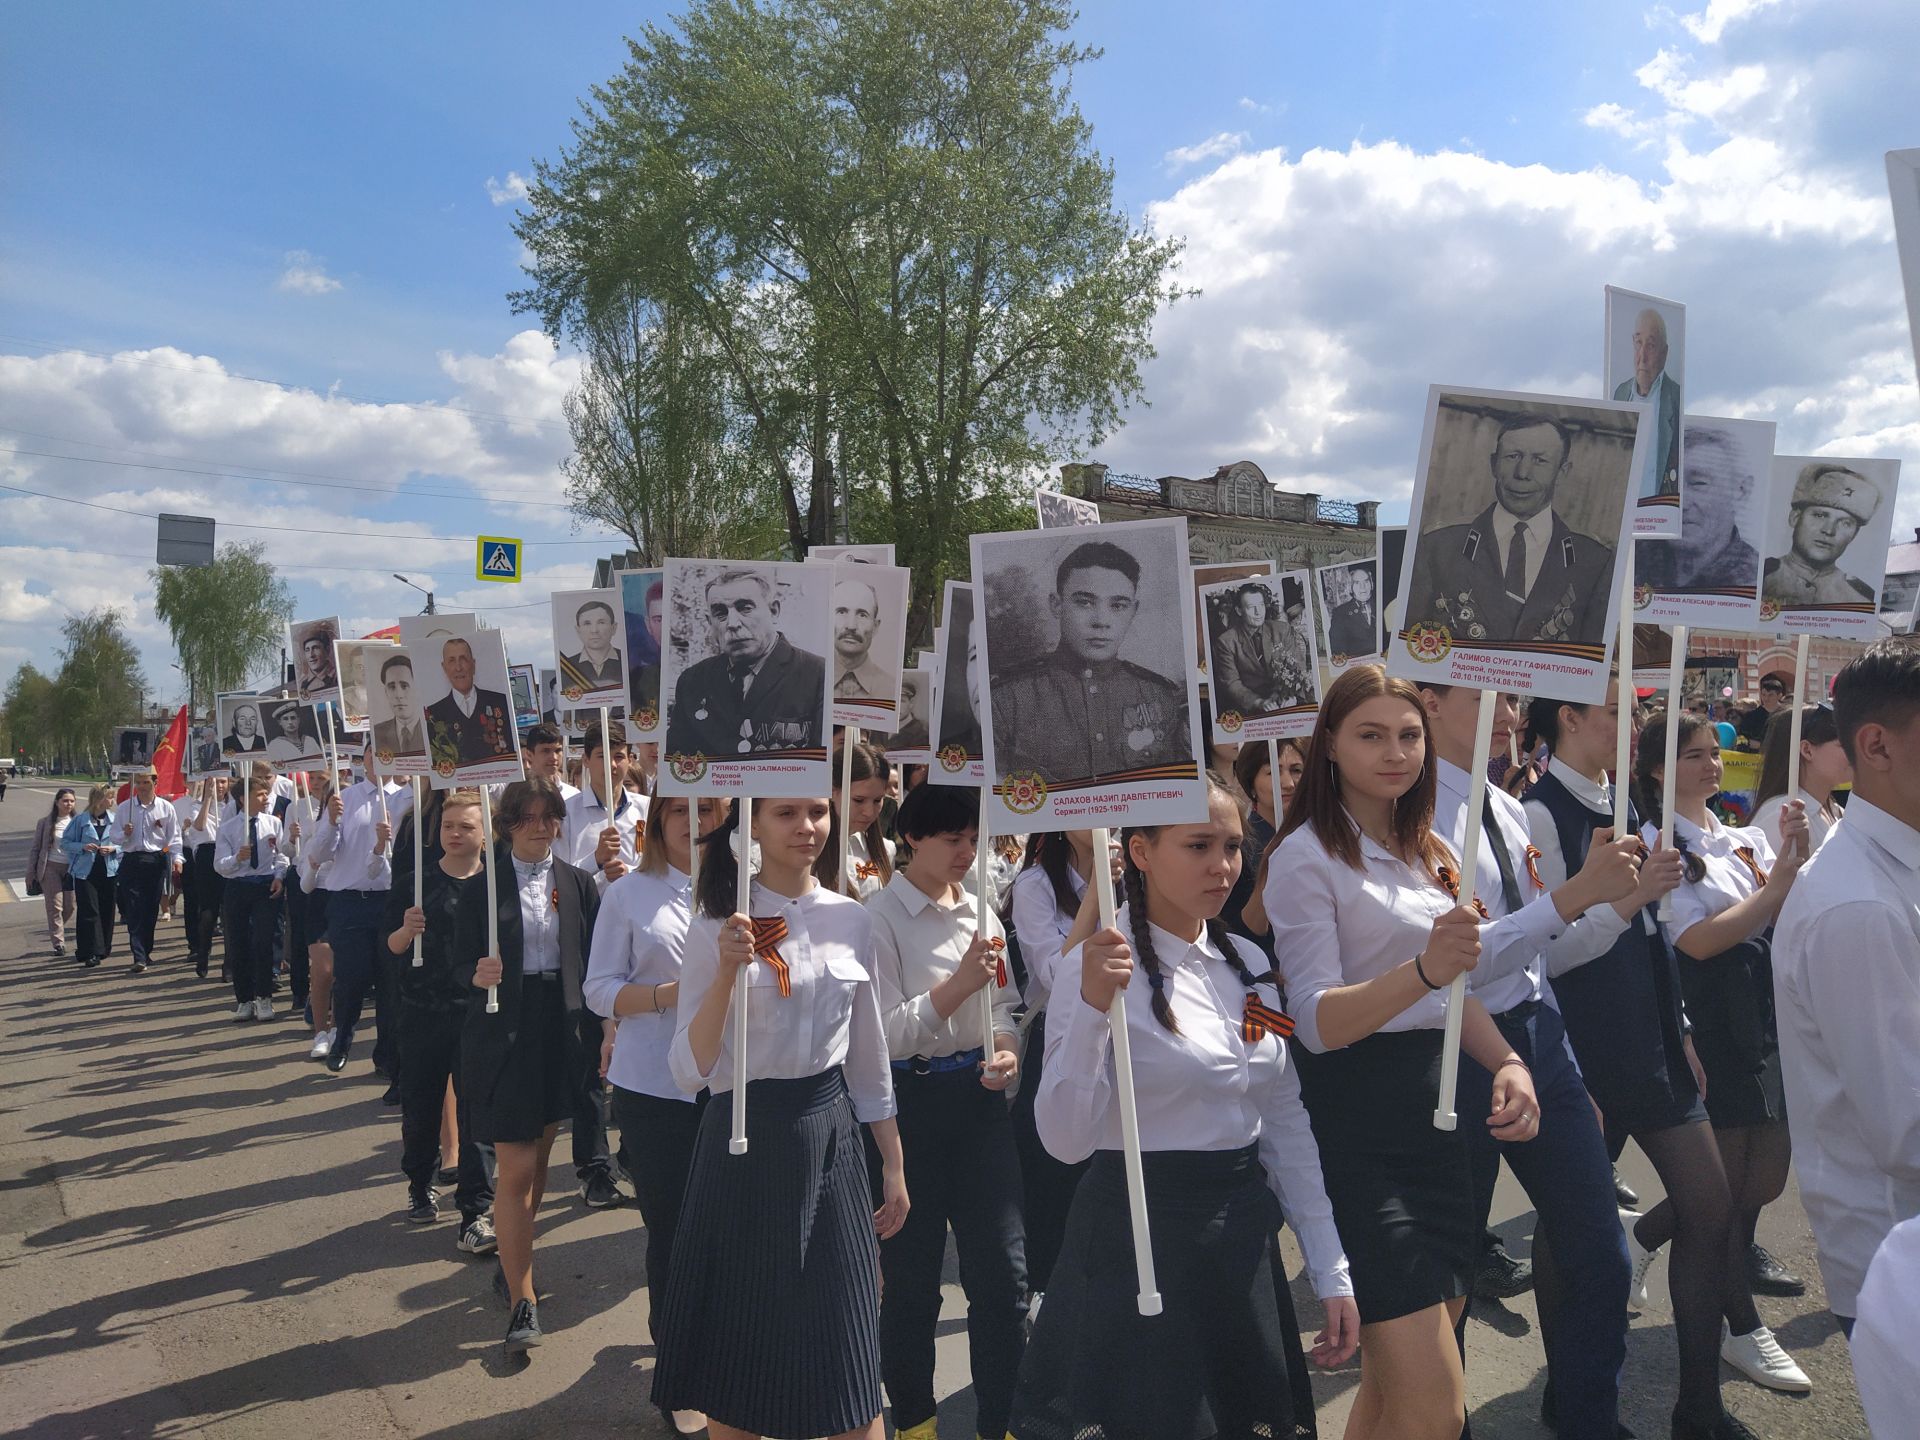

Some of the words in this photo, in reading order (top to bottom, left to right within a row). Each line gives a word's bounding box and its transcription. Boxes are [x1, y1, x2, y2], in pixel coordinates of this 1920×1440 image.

[1682, 598, 1716, 606] АЛЕКСАНДР
[1451, 661, 1486, 673] Рядовой,
[1488, 667, 1532, 679] пулеметчик
[1453, 651, 1491, 663] ГАЛИМОВ
[1492, 656, 1523, 668] СУНГАТ
[1524, 660, 1594, 676] ГАФИАТУЛЛОВИЧ
[1053, 797, 1091, 806] САЛАХОВ
[1093, 794, 1119, 803] НАЗИП
[1120, 790, 1184, 803] ДАВЛЕТГИЕВИЧ
[1054, 808, 1086, 817] Сержант
[1088, 804, 1130, 815] (1925-1997)
